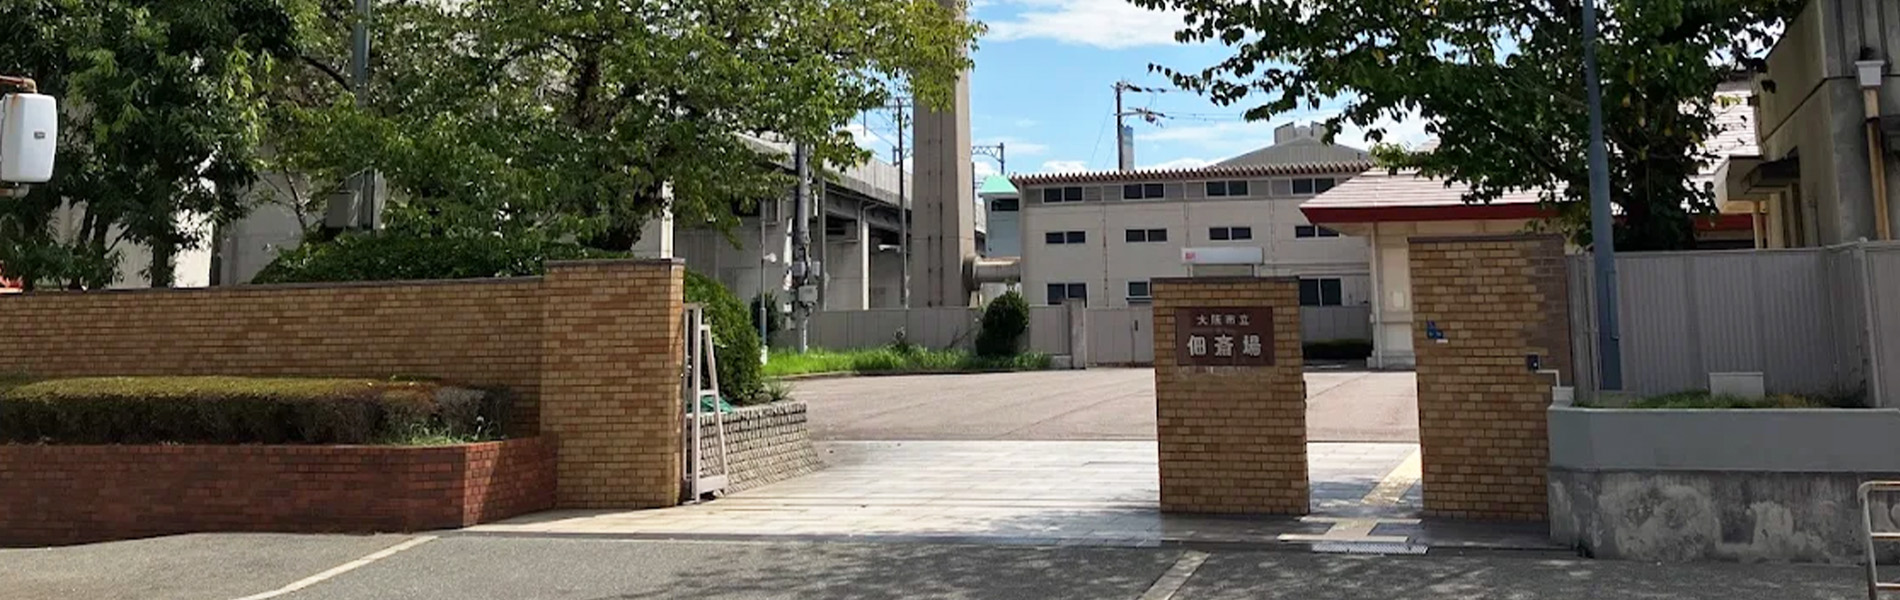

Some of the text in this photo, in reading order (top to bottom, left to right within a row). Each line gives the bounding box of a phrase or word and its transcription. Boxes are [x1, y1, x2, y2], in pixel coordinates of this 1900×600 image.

[1197, 314, 1250, 326] 大阪市立
[1187, 334, 1261, 356] 佃斎場
